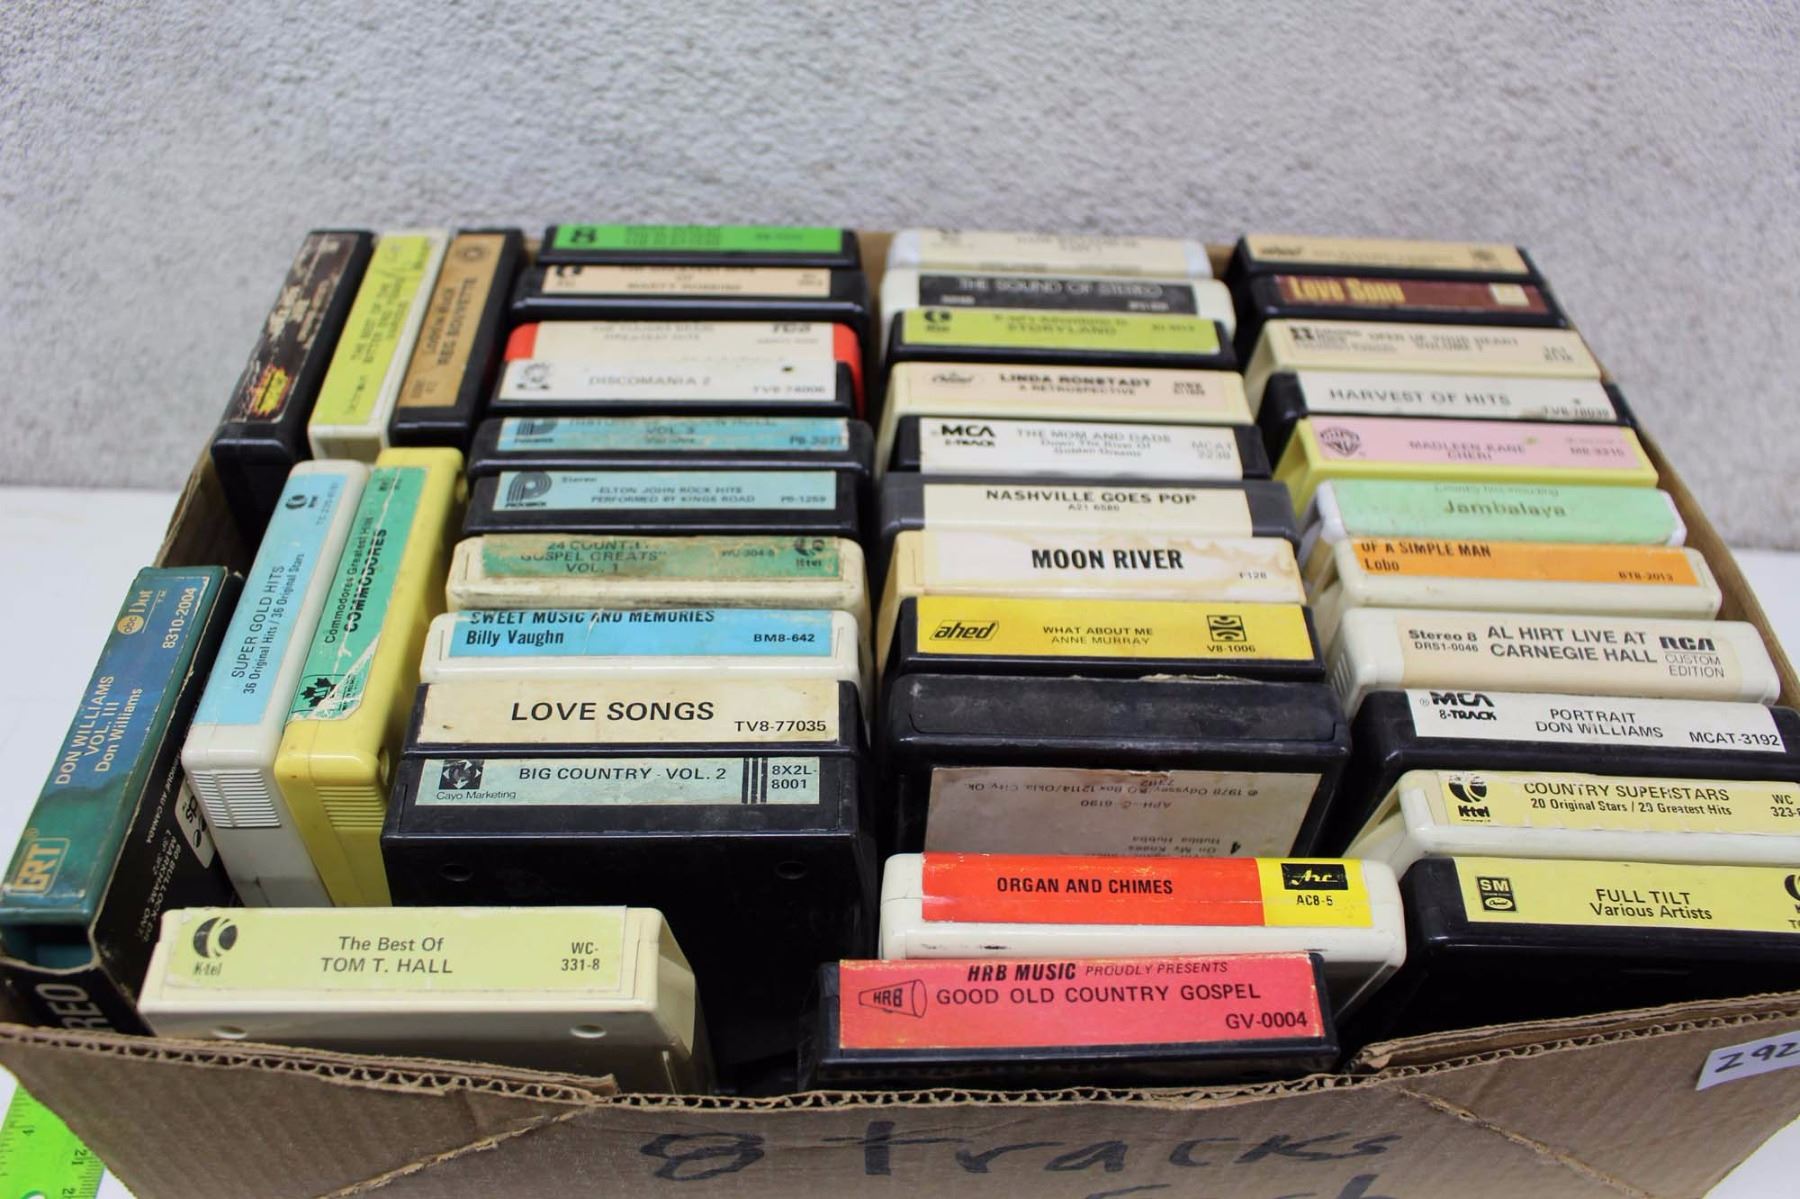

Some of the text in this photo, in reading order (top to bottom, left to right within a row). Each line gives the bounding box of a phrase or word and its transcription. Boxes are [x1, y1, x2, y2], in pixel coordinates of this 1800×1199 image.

[999, 373, 1052, 384] LINDA
[1329, 387, 1512, 406] HARVEST OF HITS
[941, 425, 995, 438] MCA
[985, 489, 1196, 505] NASHVILLE GOES POP
[1443, 499, 1567, 518] Jambalaya
[1384, 543, 1395, 554] A
[1399, 542, 1456, 557] SIMPLE
[1459, 544, 1491, 558] MAN
[565, 563, 605, 573] VOL.
[1031, 549, 1184, 570] MOON RIVER
[1364, 557, 1400, 573] Lobo
[275, 573, 297, 606] Original
[343, 528, 388, 634] COMMODORES
[162, 586, 199, 650] 8310-2004
[270, 606, 285, 619] 36
[324, 576, 355, 645] Commodores
[470, 611, 528, 625] SWEET
[532, 610, 584, 625] MUSIC
[628, 609, 716, 623] MEMORIES
[231, 564, 286, 679] SUPER GOLD HITS
[261, 625, 278, 644] Hits
[466, 629, 565, 647] Billy Vaughn
[753, 632, 816, 643] BM8-642
[936, 622, 996, 640] ahed
[1043, 626, 1153, 637] WHAT ABOUT ME
[1408, 629, 1478, 643] Stereo 8
[1487, 626, 1648, 646] AL HIRT LIVE AT
[1051, 635, 1151, 646] ANNE MURRAY
[1659, 635, 1716, 652] RCA
[248, 645, 271, 680] Original
[1490, 643, 1658, 664] CARNEGIE HALL
[1664, 652, 1722, 666] CUSTOM
[1668, 663, 1726, 679] EDITION
[242, 681, 257, 695] 36
[1429, 690, 1495, 708] MCA
[511, 700, 715, 722] LOVE SONGS
[1439, 708, 1498, 722] 8-TRACK
[1549, 708, 1637, 725] PORTRAIT
[54, 674, 115, 785] DON WILLIAMS
[82, 700, 120, 758] VOL. III
[94, 687, 144, 773] Don Williams
[733, 719, 827, 733] TV8-77035
[1535, 720, 1665, 740] DON WILLIAMS
[1688, 730, 1781, 748] MCAT-3192
[518, 766, 727, 781] BIG COUNTRY VOL. 2
[771, 778, 808, 790] 8001
[1523, 782, 1731, 802] COUNTRY SUPERSTARS
[435, 790, 517, 803] Cayo Marketing
[1771, 793, 1795, 806] WC
[1457, 805, 1491, 818] K-tel
[1530, 797, 1548, 810] 20
[1550, 797, 1597, 813] Original
[1598, 799, 1628, 813] Stars
[1656, 801, 1706, 816] Greatest
[1707, 803, 1733, 817] Hits
[996, 876, 1175, 895] ORGAN AND CHIMES
[1479, 878, 1512, 893] SM
[1295, 894, 1335, 907] AC8-5
[1595, 888, 1691, 906] FULL TILT
[1590, 901, 1713, 921] Various Artists
[337, 935, 446, 953] The Best Of
[570, 941, 601, 955] WC-
[320, 957, 454, 974] TOM T. HALL
[560, 957, 601, 972] 331-8
[967, 960, 1229, 981] HRB MUSIC PROUDLY PRESENTS
[872, 987, 904, 1008] HRB
[936, 982, 1262, 1006] GOOD OLD COUNTRY GOSPEL
[1224, 1010, 1309, 1030] GV-0004
[639, 1131, 767, 1181] 8
